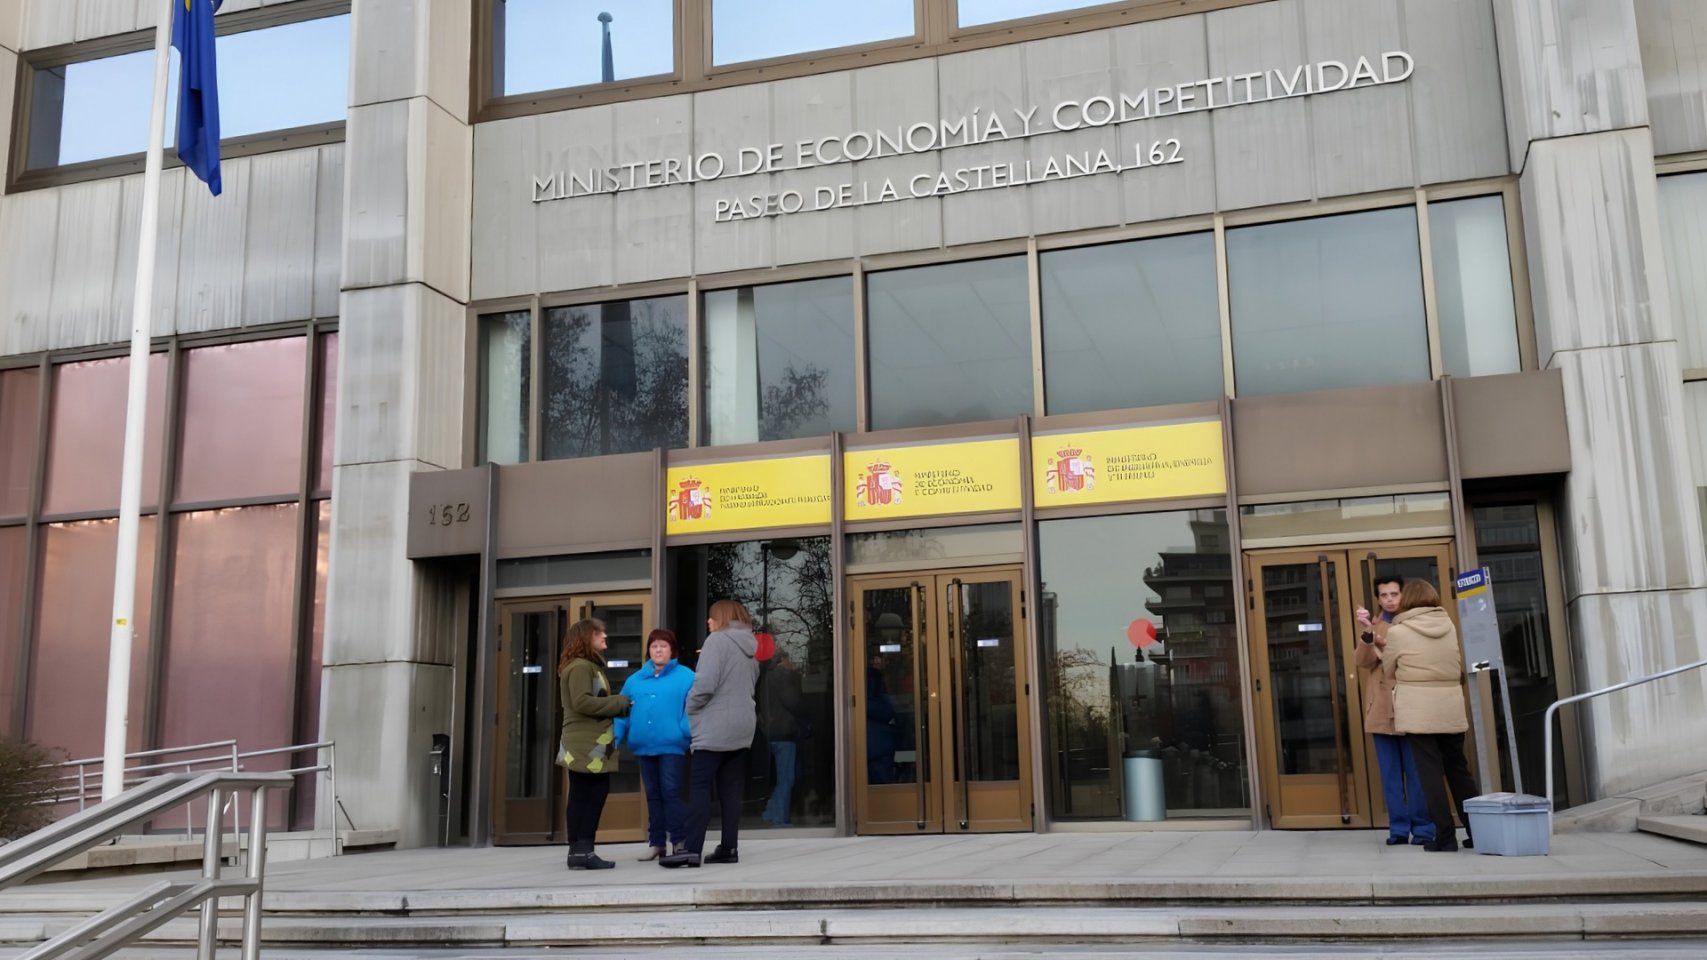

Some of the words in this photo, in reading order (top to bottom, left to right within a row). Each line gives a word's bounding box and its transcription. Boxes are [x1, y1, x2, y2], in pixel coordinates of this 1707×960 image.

[533, 153, 724, 203] MINISTERIO
[739, 143, 784, 175] DE
[796, 107, 1009, 168] ECONOMÍA
[1014, 105, 1038, 136] Y
[1052, 50, 1415, 132] COMPETITIVIDAD
[715, 190, 804, 223] PASEO
[815, 183, 853, 211] DE
[864, 176, 901, 203] LA
[910, 148, 1122, 198] CASTELLANA,
[1135, 137, 1184, 167] 162
